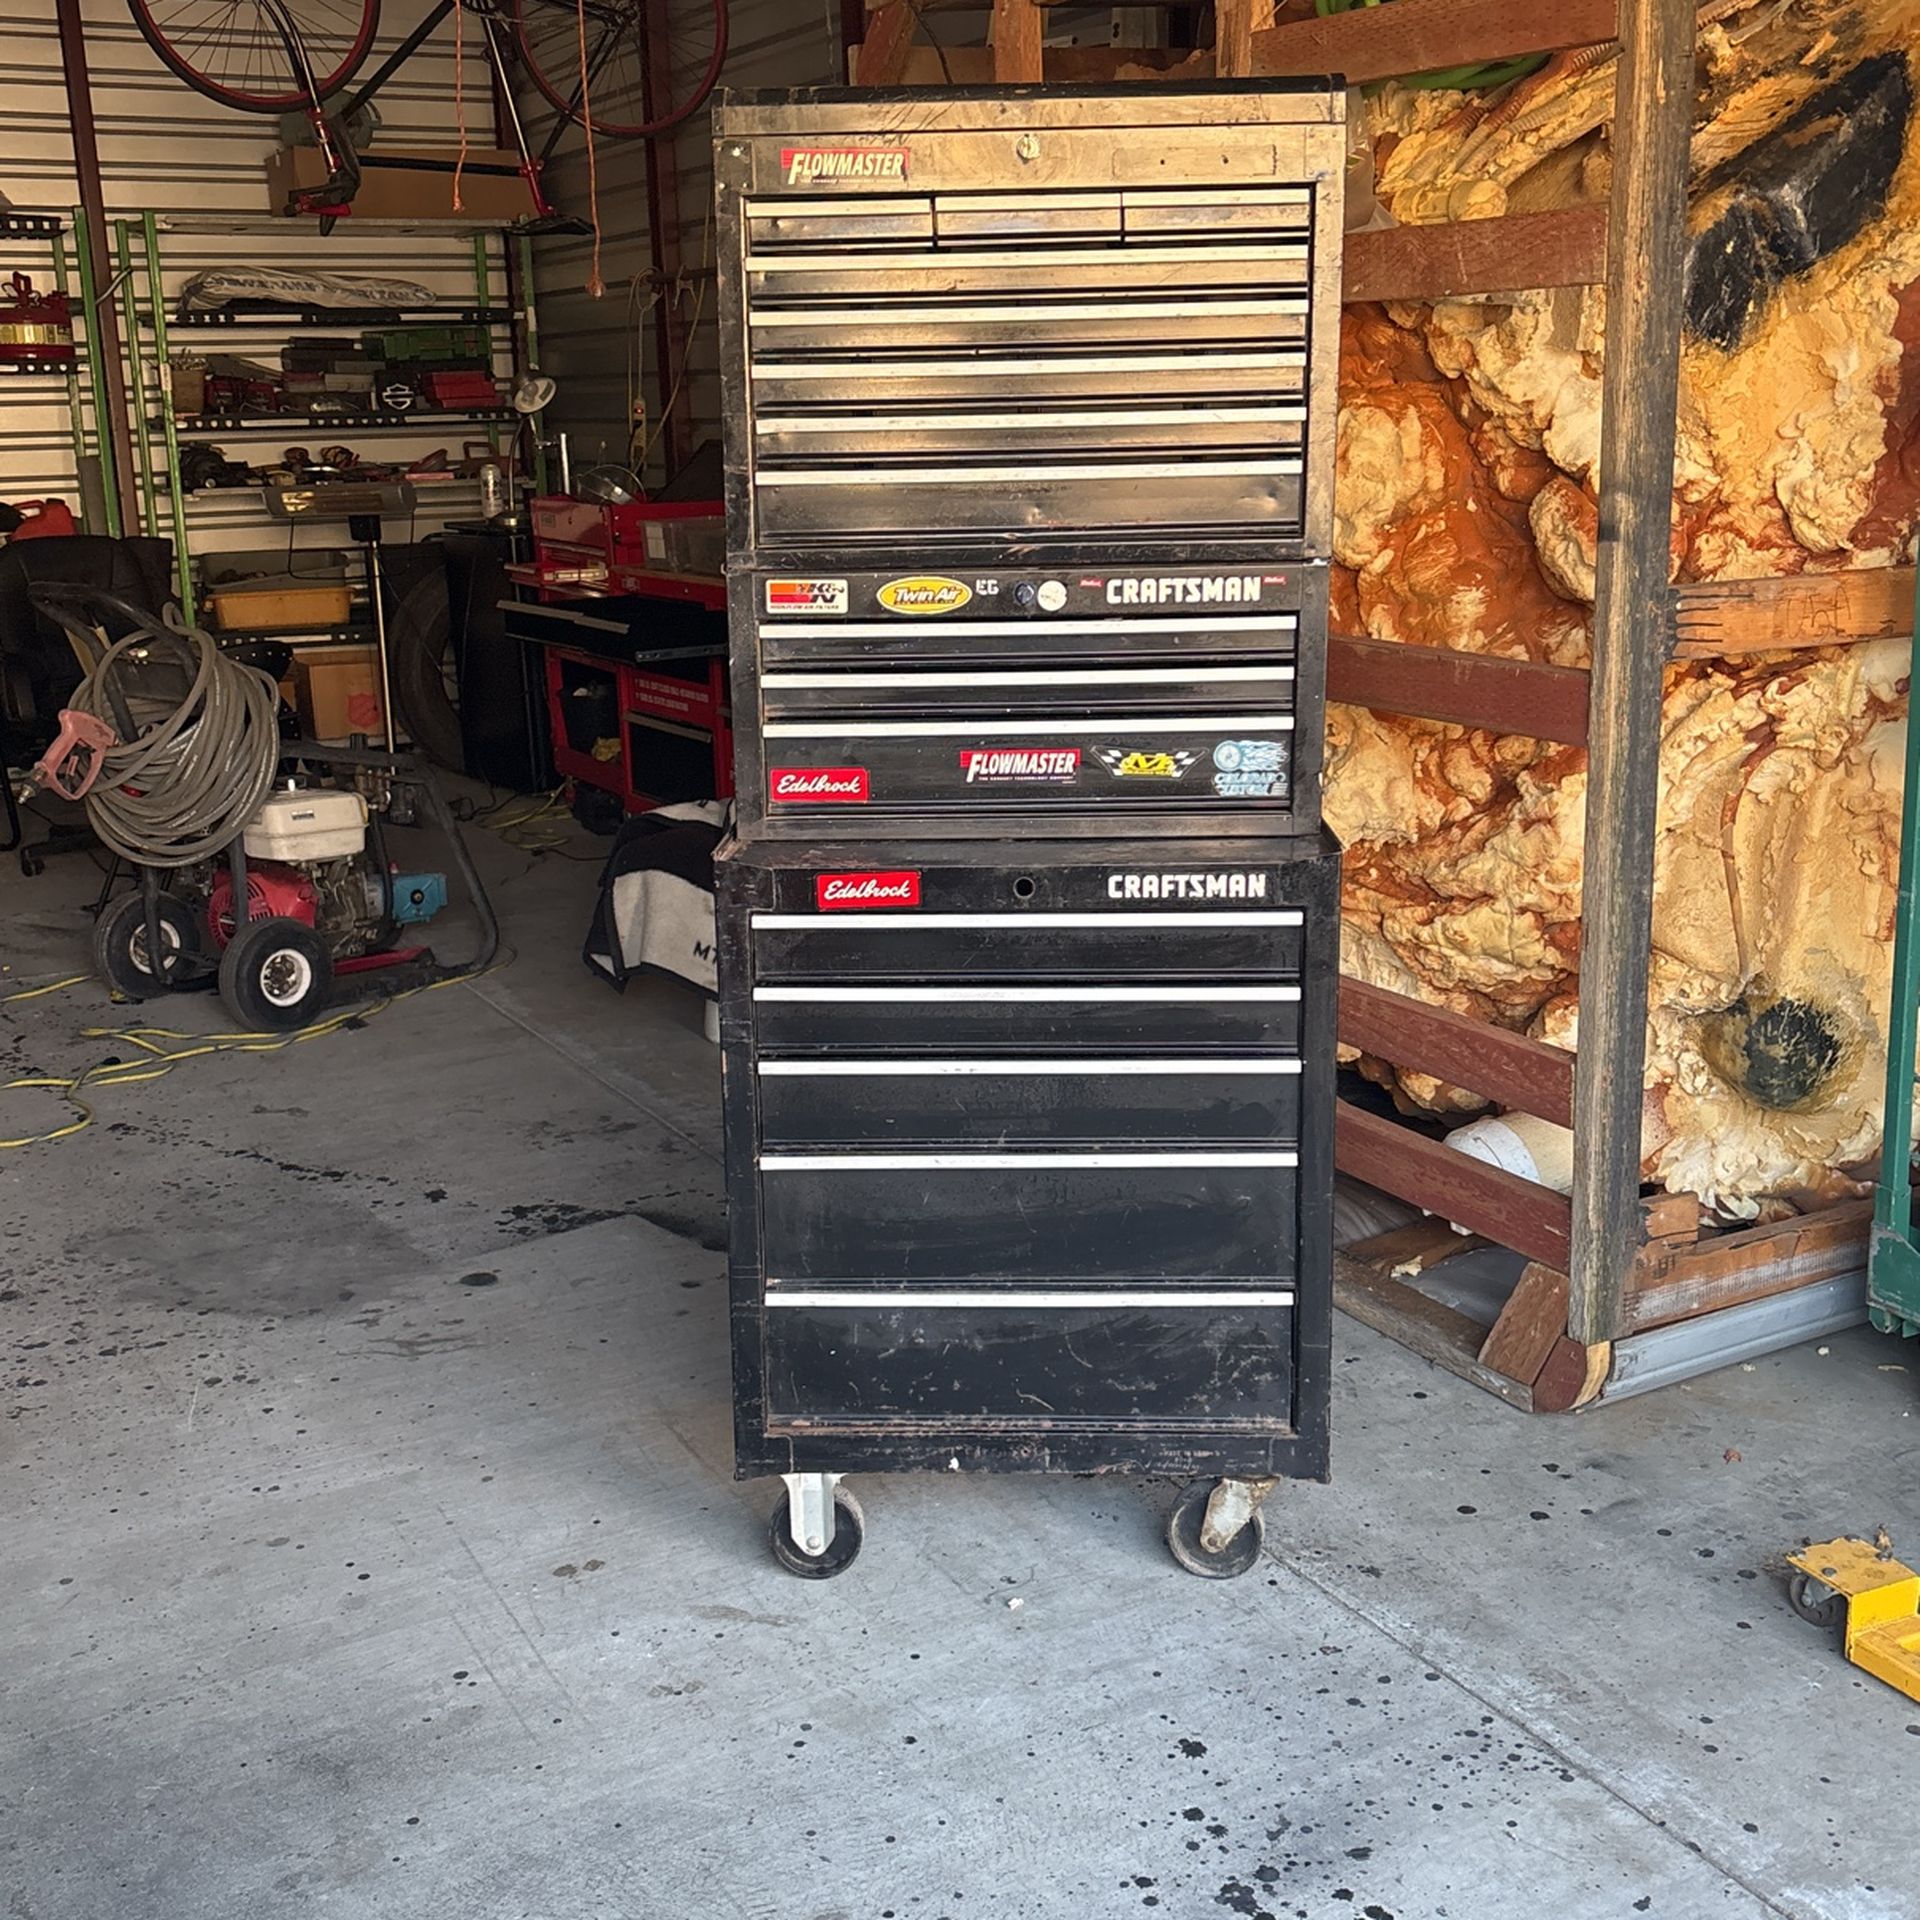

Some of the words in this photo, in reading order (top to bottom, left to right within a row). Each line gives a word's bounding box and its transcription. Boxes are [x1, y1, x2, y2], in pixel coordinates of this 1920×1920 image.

[787, 152, 905, 185] FLOWMASTER
[894, 587, 935, 604] Twin
[934, 586, 962, 603] Air
[1106, 576, 1262, 604] CRAFTSMAN
[966, 752, 1076, 783] FLOWMASTER
[776, 774, 861, 794] Edelbrock
[823, 879, 912, 901] Edelbrock
[1107, 873, 1267, 899] CRAFTSMAN
